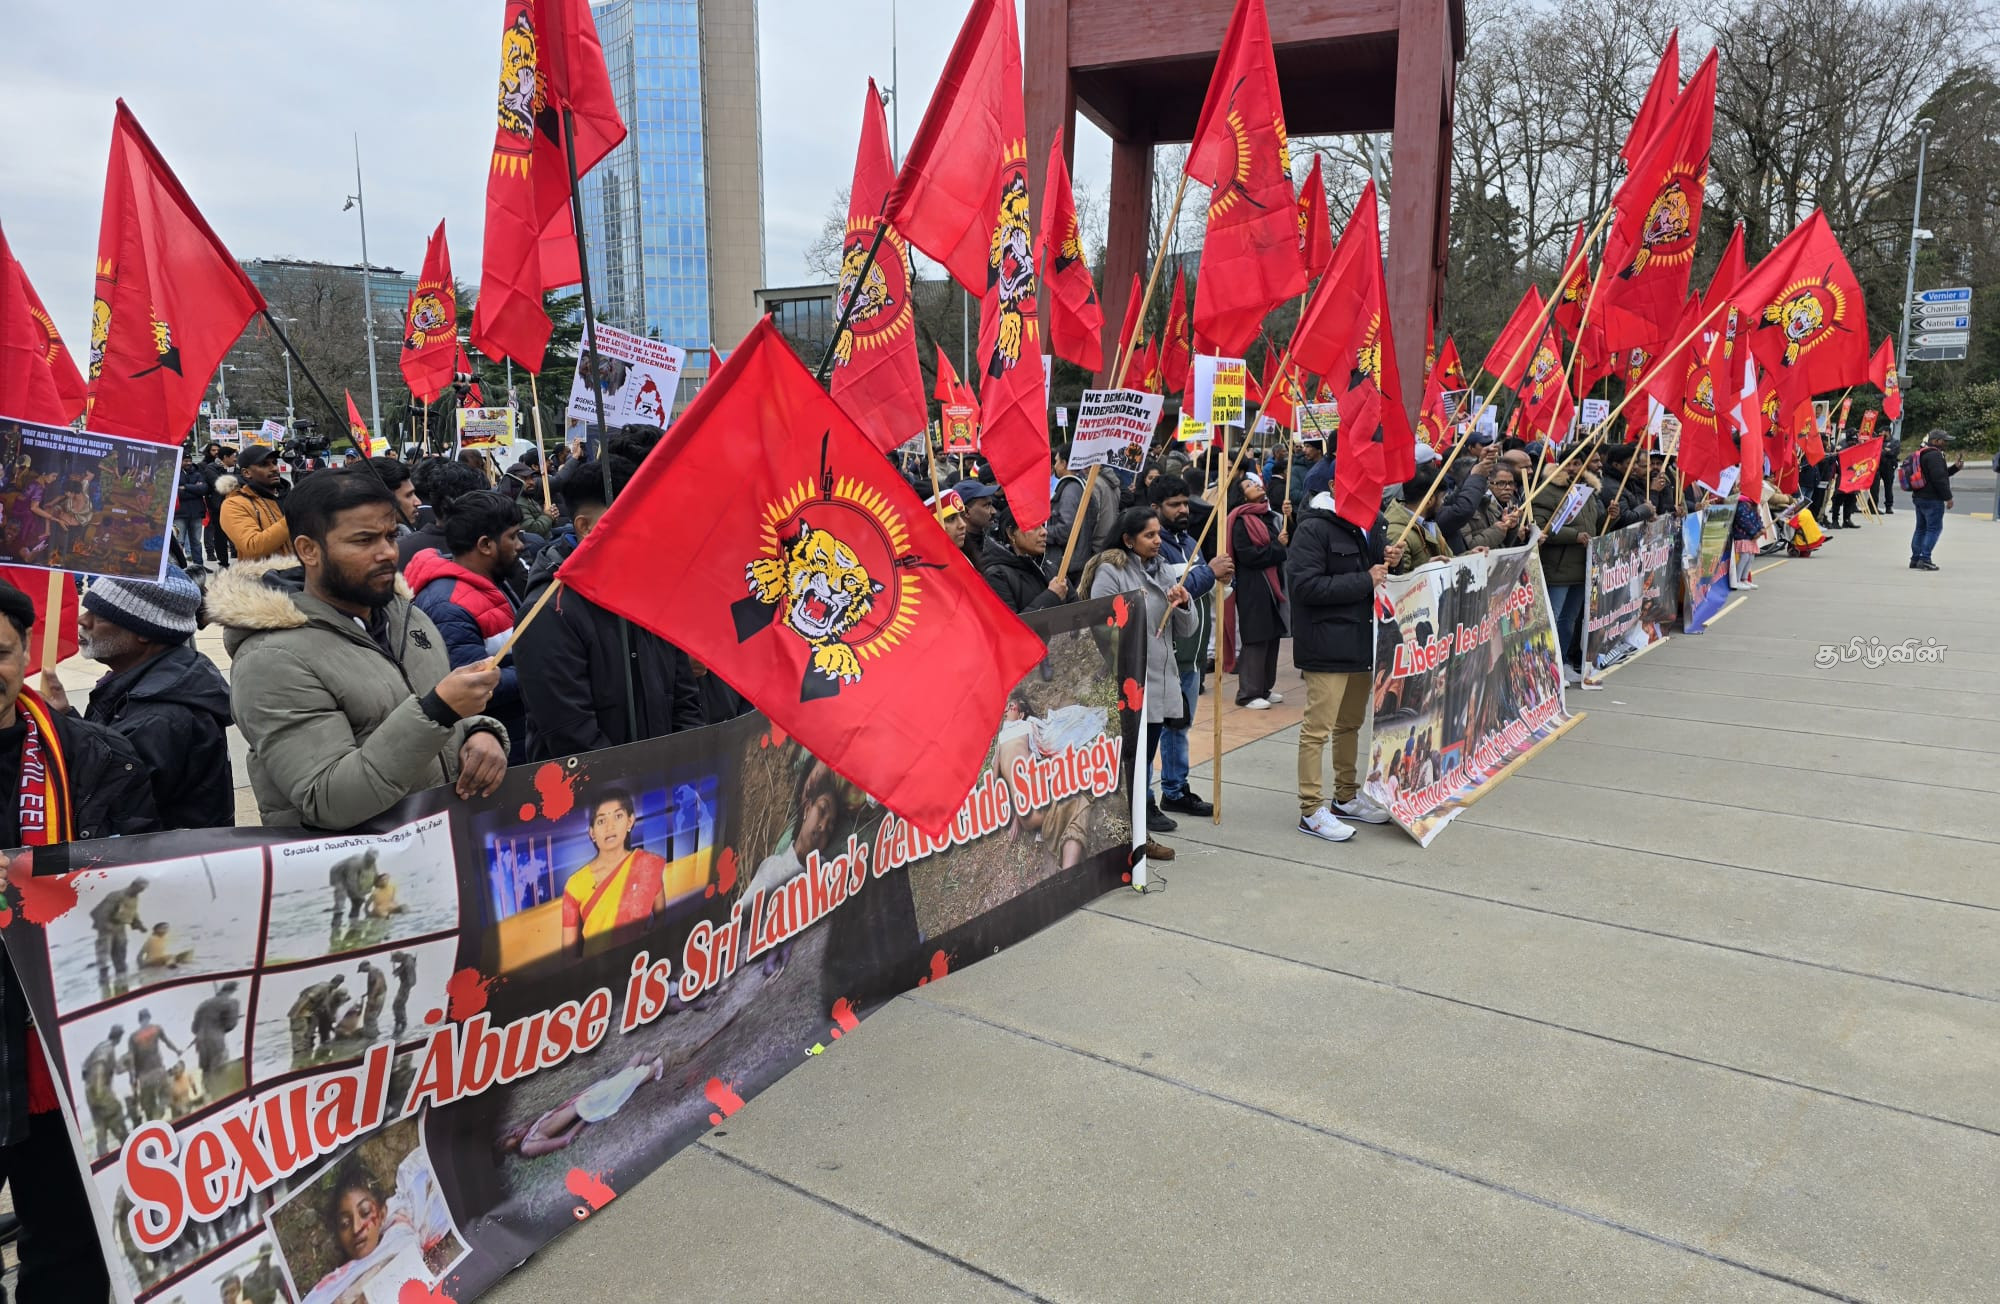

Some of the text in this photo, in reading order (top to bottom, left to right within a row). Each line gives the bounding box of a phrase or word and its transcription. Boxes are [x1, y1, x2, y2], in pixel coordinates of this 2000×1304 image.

[1926, 304, 1967, 313] Charmilles
[1928, 291, 1957, 301] Vernier
[1926, 319, 1955, 328] Nations
[630, 337, 642, 346] SRI
[643, 342, 668, 353] LANKA
[633, 346, 643, 354] DE
[1085, 392, 1143, 404] WE DEMAND
[1081, 404, 1151, 419] INDEPENDENT
[21, 428, 113, 450] WHAT ARE THE HUMAN RIGHTS
[23, 438, 34, 446] FOR
[34, 439, 57, 450] TAMILS
[58, 443, 66, 451] IN
[67, 444, 79, 453] SRI
[79, 446, 101, 457] LANKA
[1602, 557, 1630, 595] Justice
[1392, 632, 1454, 679] Libérer
[1454, 622, 1479, 656] les
[1519, 694, 1562, 732] librement
[1492, 730, 1512, 756] de
[1504, 718, 1532, 747] vivre
[1474, 733, 1502, 773] droit
[1450, 764, 1471, 792] ont
[1401, 777, 1451, 819] Tamouls
[19, 793, 44, 848] EEL
[1391, 801, 1412, 825] es
[122, 1041, 394, 1252] Sexual
[401, 987, 611, 1117] Abuse
[620, 950, 671, 1035] is
[678, 899, 743, 1001] Sri
[745, 834, 868, 963] Lanka's
[1010, 733, 1124, 817] Strategy
